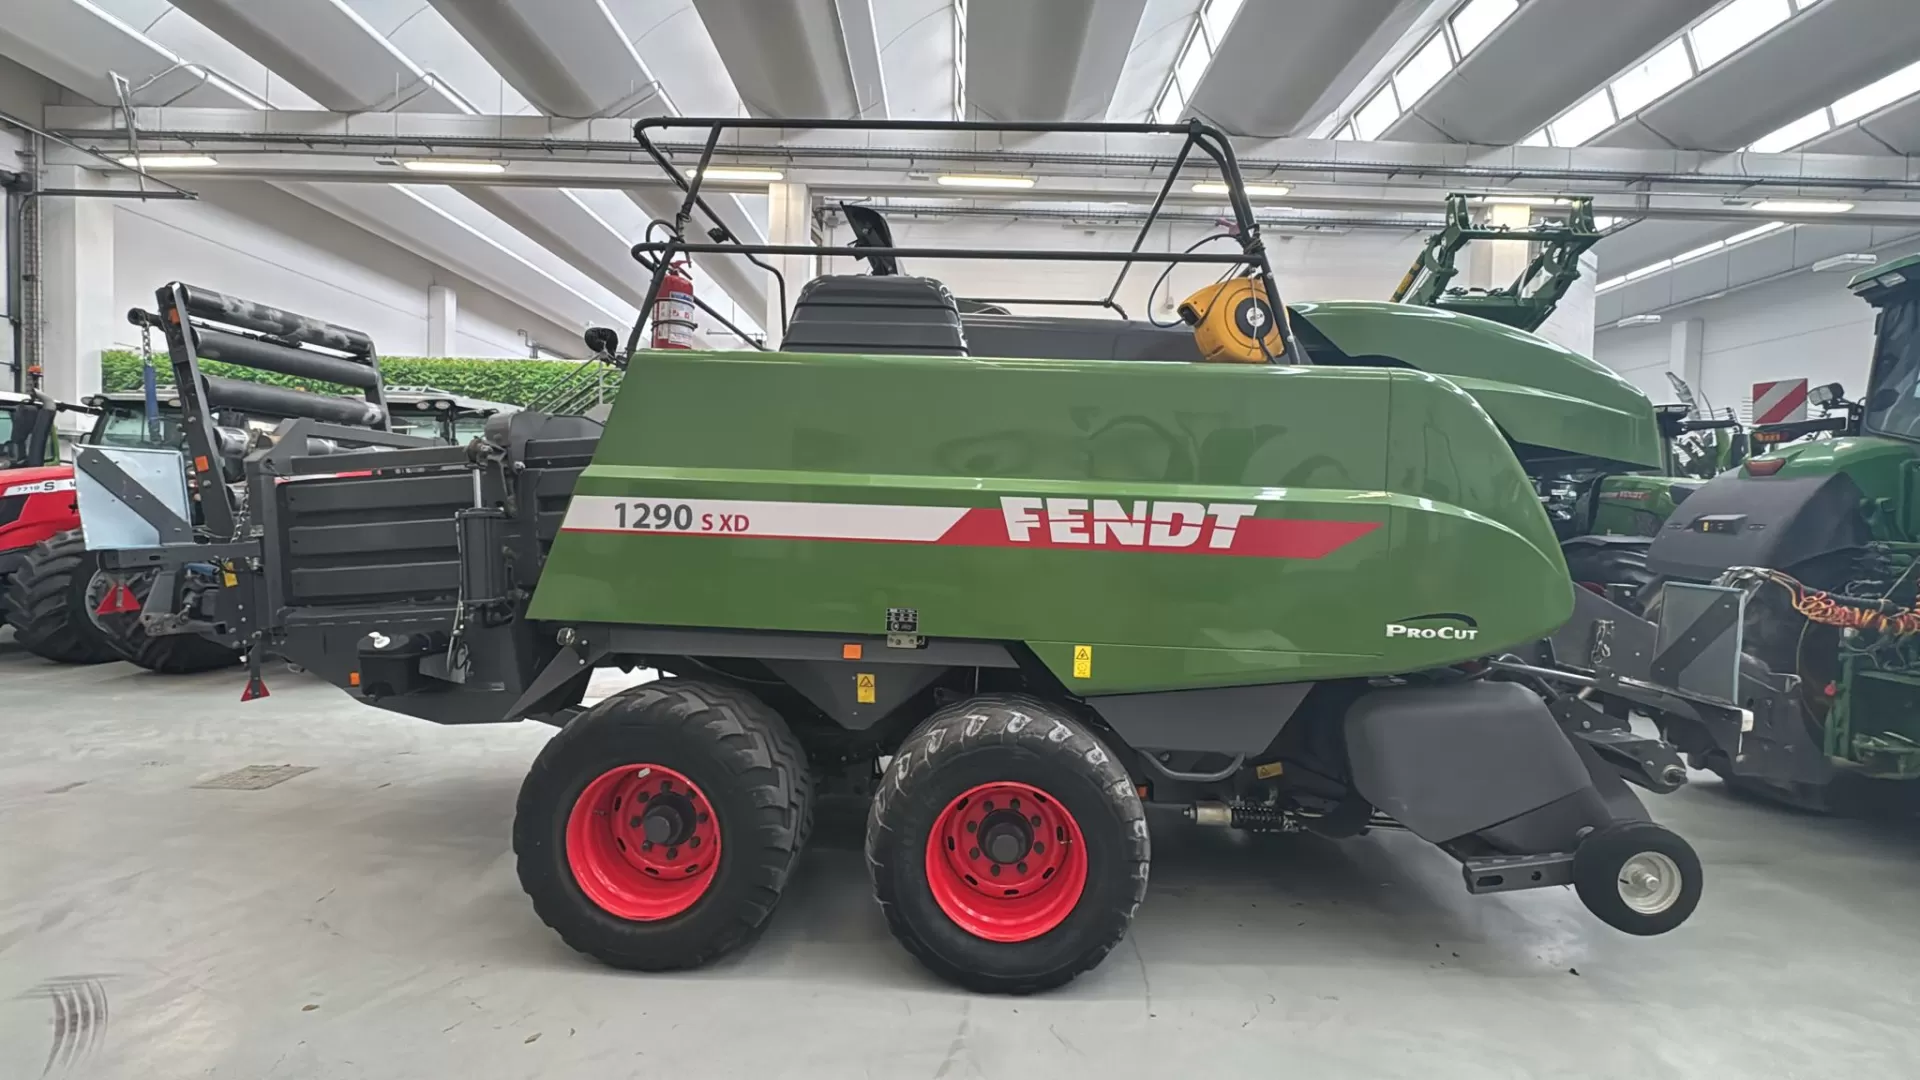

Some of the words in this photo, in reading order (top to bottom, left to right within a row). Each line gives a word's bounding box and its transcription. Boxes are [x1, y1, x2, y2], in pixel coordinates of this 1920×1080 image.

[44, 481, 55, 491] S
[614, 502, 693, 531] 1290
[701, 513, 713, 532] S
[719, 514, 750, 532] XD
[1000, 496, 1258, 549] FENDT
